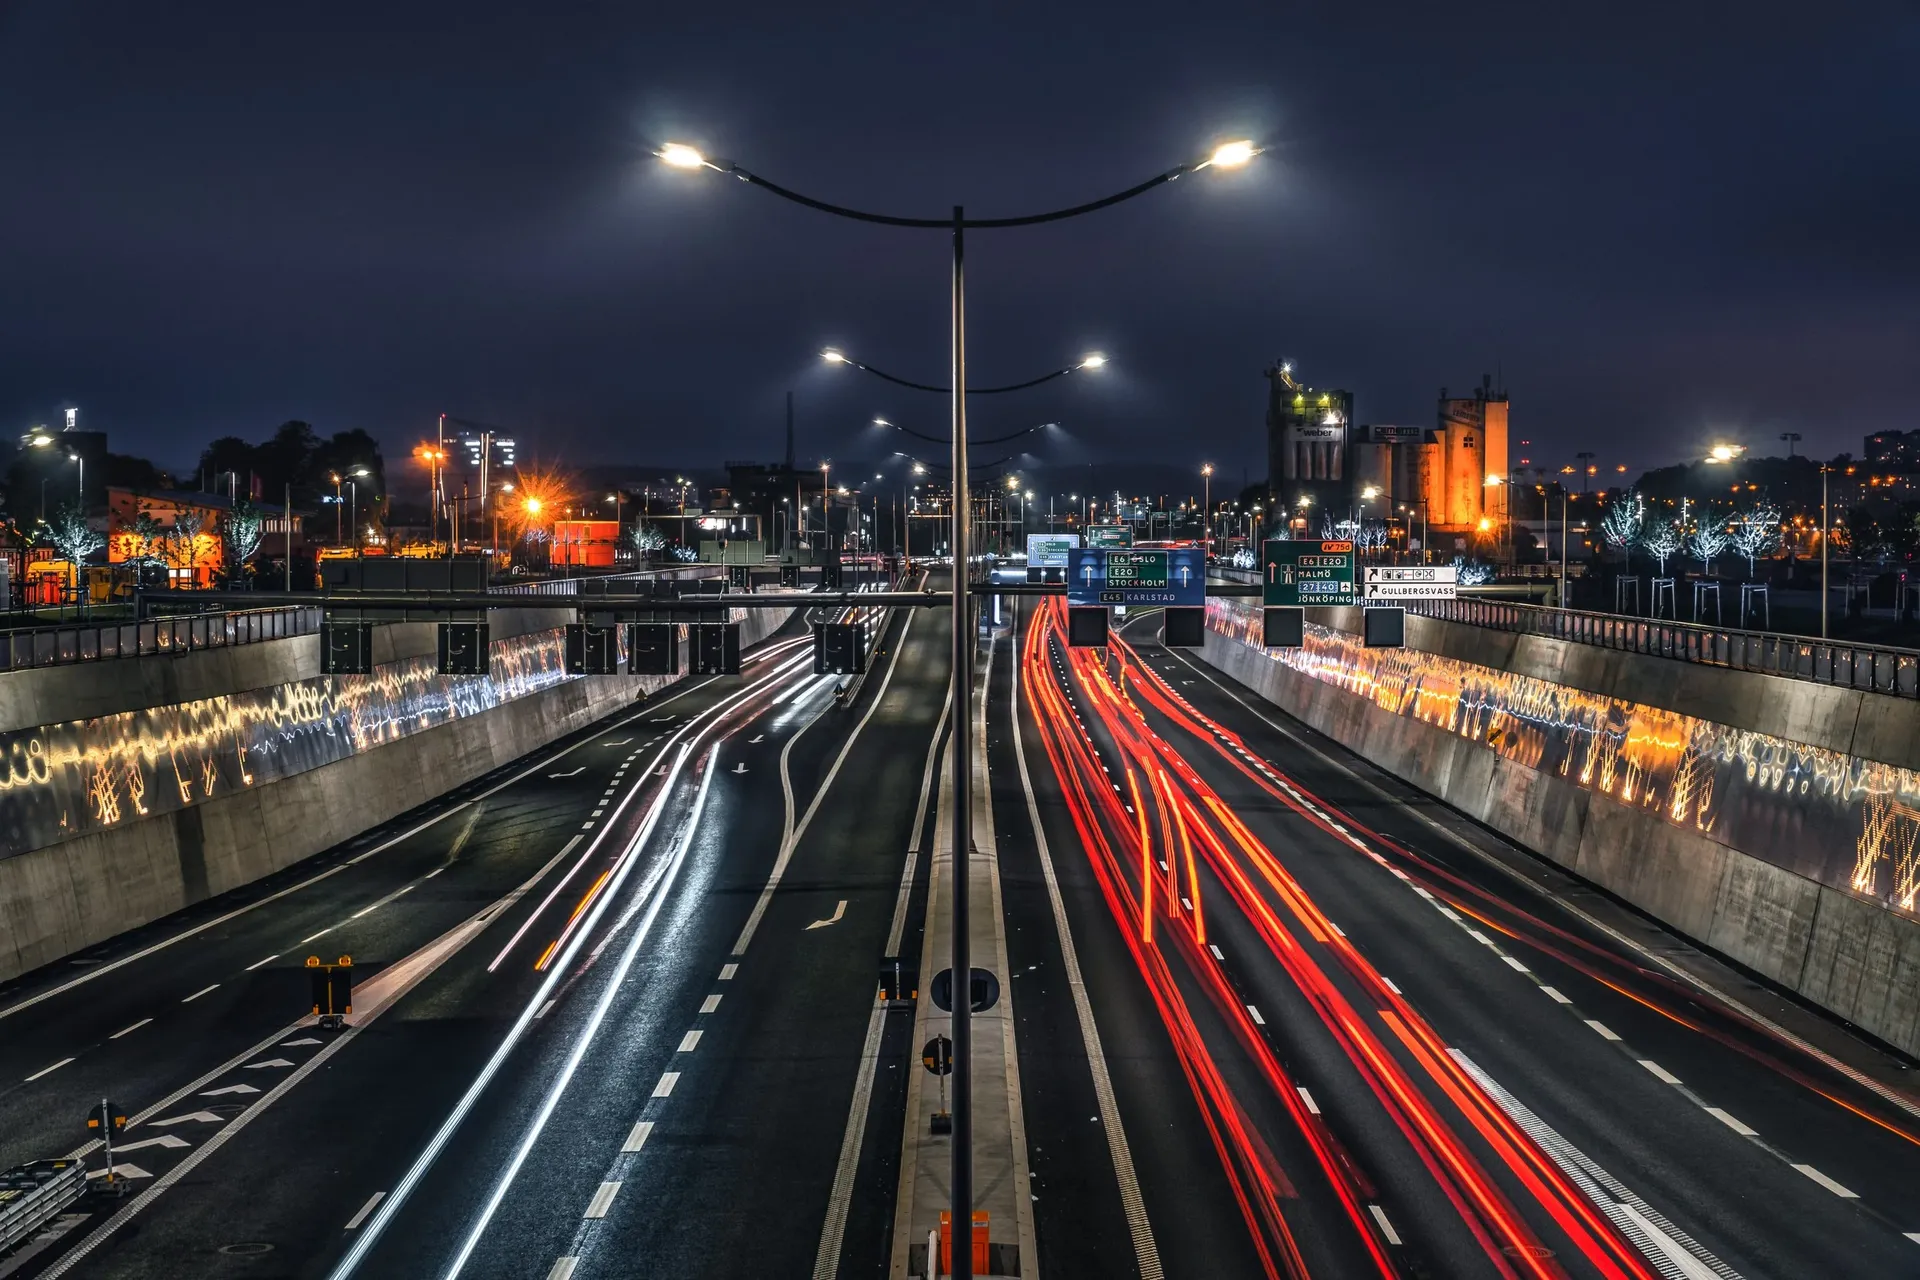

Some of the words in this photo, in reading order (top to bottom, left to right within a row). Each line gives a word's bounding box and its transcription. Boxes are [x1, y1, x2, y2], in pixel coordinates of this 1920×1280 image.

[1303, 428, 1333, 437] weber
[1114, 568, 1133, 576] E20
[1298, 569, 1331, 578] MALMÖ
[1109, 579, 1165, 587] STOCKHOLM
[1302, 583, 1314, 591] 27
[1321, 583, 1335, 591] 40
[1381, 587, 1455, 595] GULLBERGSVASS
[1103, 593, 1121, 601] E45
[1127, 593, 1176, 601] KARLSTAD
[1298, 594, 1352, 603] JÖNKÖPING
